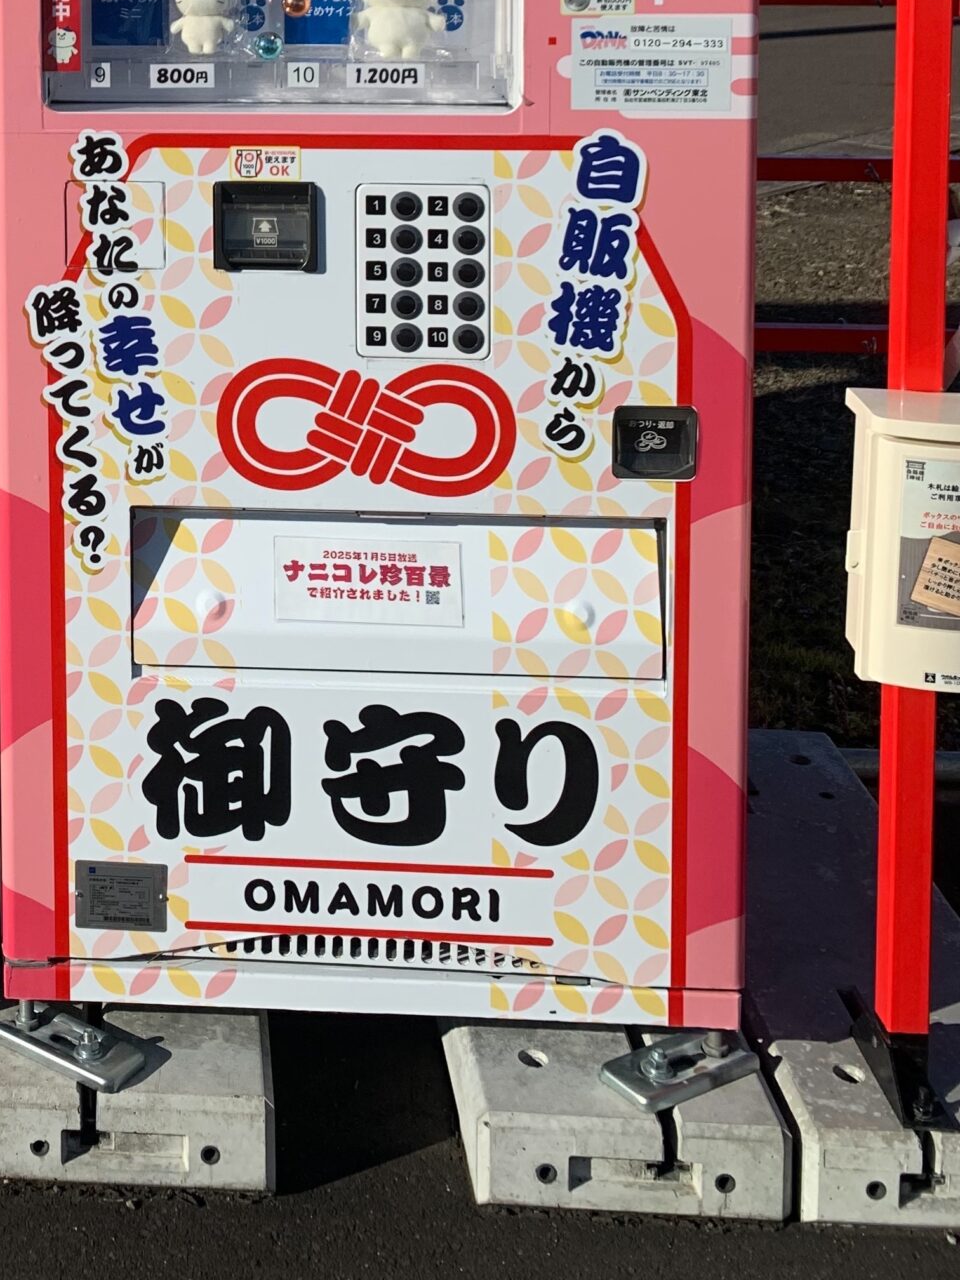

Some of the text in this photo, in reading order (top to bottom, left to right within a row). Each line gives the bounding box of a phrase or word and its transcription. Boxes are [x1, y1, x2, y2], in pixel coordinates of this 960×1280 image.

[580, 31, 627, 49] DRINK
[95, 67, 105, 82] 9
[157, 69, 208, 83] 800円
[292, 67, 315, 82] 10
[270, 166, 290, 176] OK
[373, 201, 379, 210] 1
[435, 201, 442, 210] 2
[373, 234, 380, 244] 3
[434, 234, 442, 244] 4
[374, 266, 381, 275] 5
[435, 267, 442, 276] 6
[545, 135, 640, 451] 自販機から
[77, 136, 165, 474] あなたの幸せが
[372, 298, 379, 308] 7
[434, 300, 442, 310] 8
[374, 331, 381, 341] 9
[432, 332, 446, 342] 10
[323, 552, 417, 562] 2025年1月5日放送
[283, 560, 451, 587] ナニコレ珍百景
[141, 697, 599, 846] 御守り
[244, 879, 500, 923] OMAMORI
